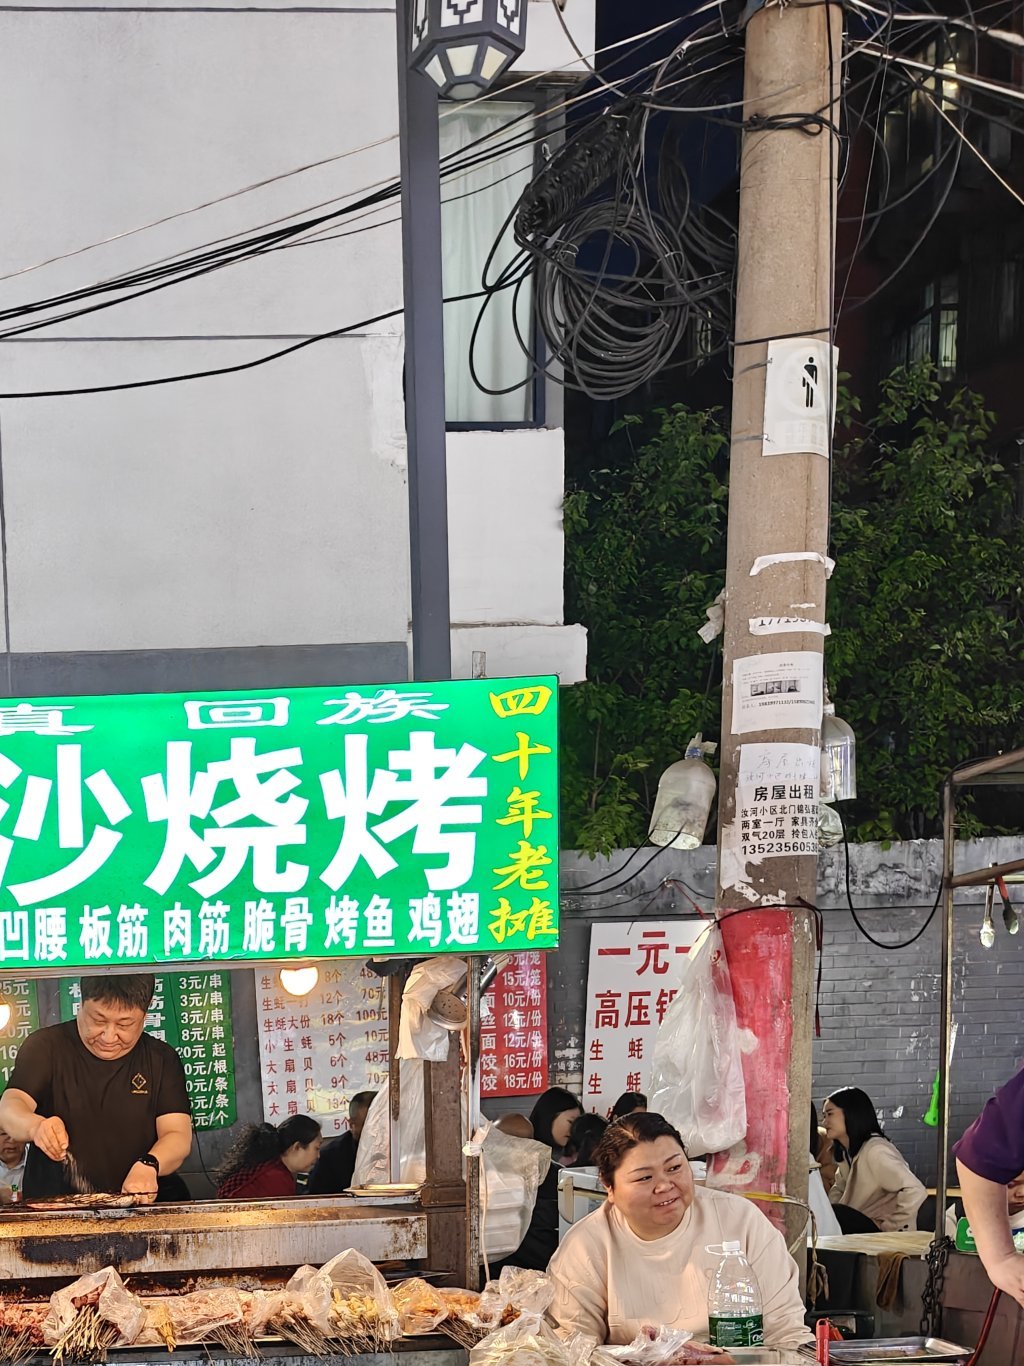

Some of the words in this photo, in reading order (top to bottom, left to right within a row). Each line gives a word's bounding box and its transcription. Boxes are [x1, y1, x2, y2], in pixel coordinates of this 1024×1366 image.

[183, 690, 450, 730] 回族
[754, 784, 814, 802] 房屋出租
[488, 685, 559, 944] 四十年老摊
[741, 817, 784, 830] 两室一厅
[741, 829, 785, 842] 双气20层
[79, 903, 149, 958] 板筋
[163, 900, 234, 955] 肉筋
[242, 896, 314, 952] 脆骨
[324, 894, 396, 949] 烤鱼
[407, 891, 480, 947] 鸡翅
[179, 973, 222, 990] 3元/串
[502, 969, 542, 987] 15元/笼
[180, 991, 223, 1007] 3元/串
[262, 996, 309, 1012] 生蚝一
[502, 989, 542, 1007] 10元/份
[181, 1008, 224, 1024] 3元/串
[263, 1014, 311, 1033] 生蚝大份
[321, 1012, 345, 1026] 18个
[356, 1008, 388, 1022] 100元
[0, 1021, 32, 1039] 0元
[181, 1025, 225, 1041] 8元/串
[328, 1032, 346, 1047] 5个
[365, 1028, 389, 1043] 10元
[503, 1030, 543, 1048] 12元/份
[0, 1044, 18, 1060] 16
[212, 1042, 226, 1057] 起
[266, 1057, 313, 1075] 大扇贝
[330, 1053, 347, 1068] 6个
[366, 1049, 389, 1063] 48元
[503, 1051, 543, 1069] 16元/份
[267, 1078, 314, 1096] 大扇贝
[331, 1074, 348, 1089] 9个
[504, 1071, 543, 1089] 18元/份
[269, 1099, 316, 1117] 大扇贝
[334, 1116, 351, 1131] 5个
